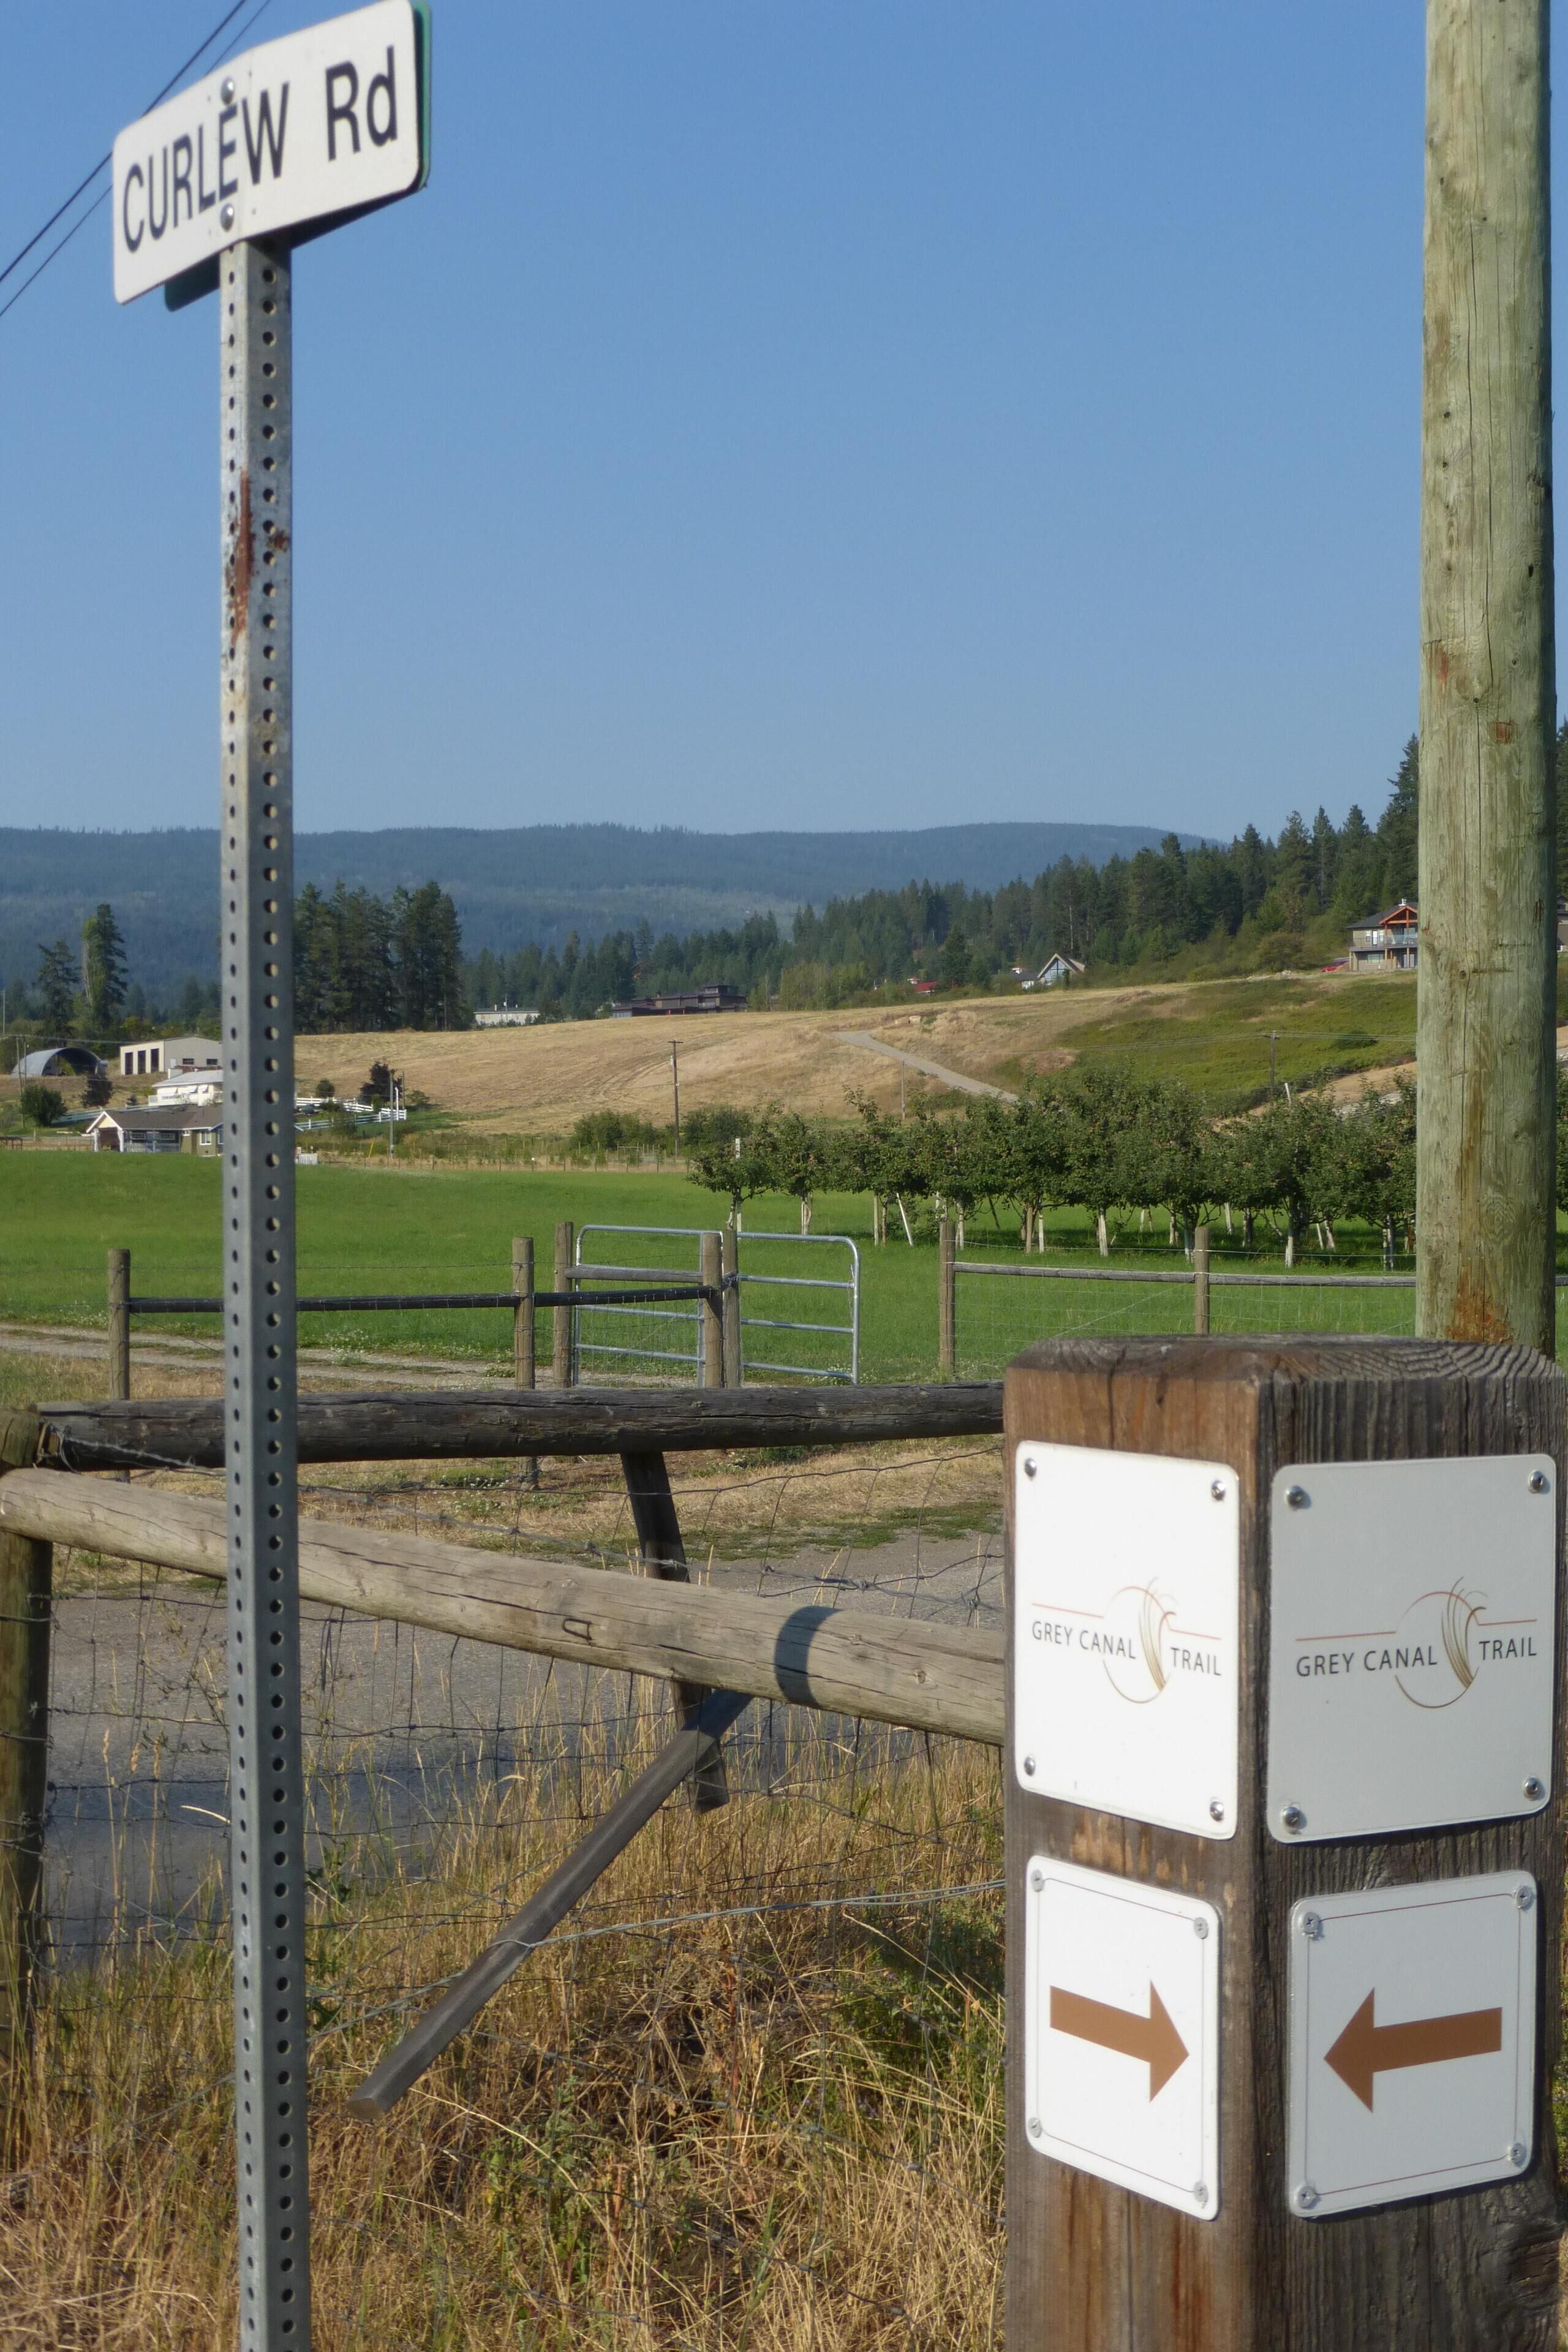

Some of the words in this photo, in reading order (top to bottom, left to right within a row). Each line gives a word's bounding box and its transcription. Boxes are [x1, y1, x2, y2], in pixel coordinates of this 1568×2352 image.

[123, 82, 289, 253] CURLEW
[325, 45, 398, 162] Rd
[1032, 1621, 1072, 1646] GREY
[1079, 1630, 1136, 1659] CANAL
[1170, 1647, 1221, 1676] TRAIL
[1296, 1652, 1354, 1677] GREY
[1363, 1646, 1438, 1671] CANAL
[1479, 1637, 1537, 1660] TRAIL
